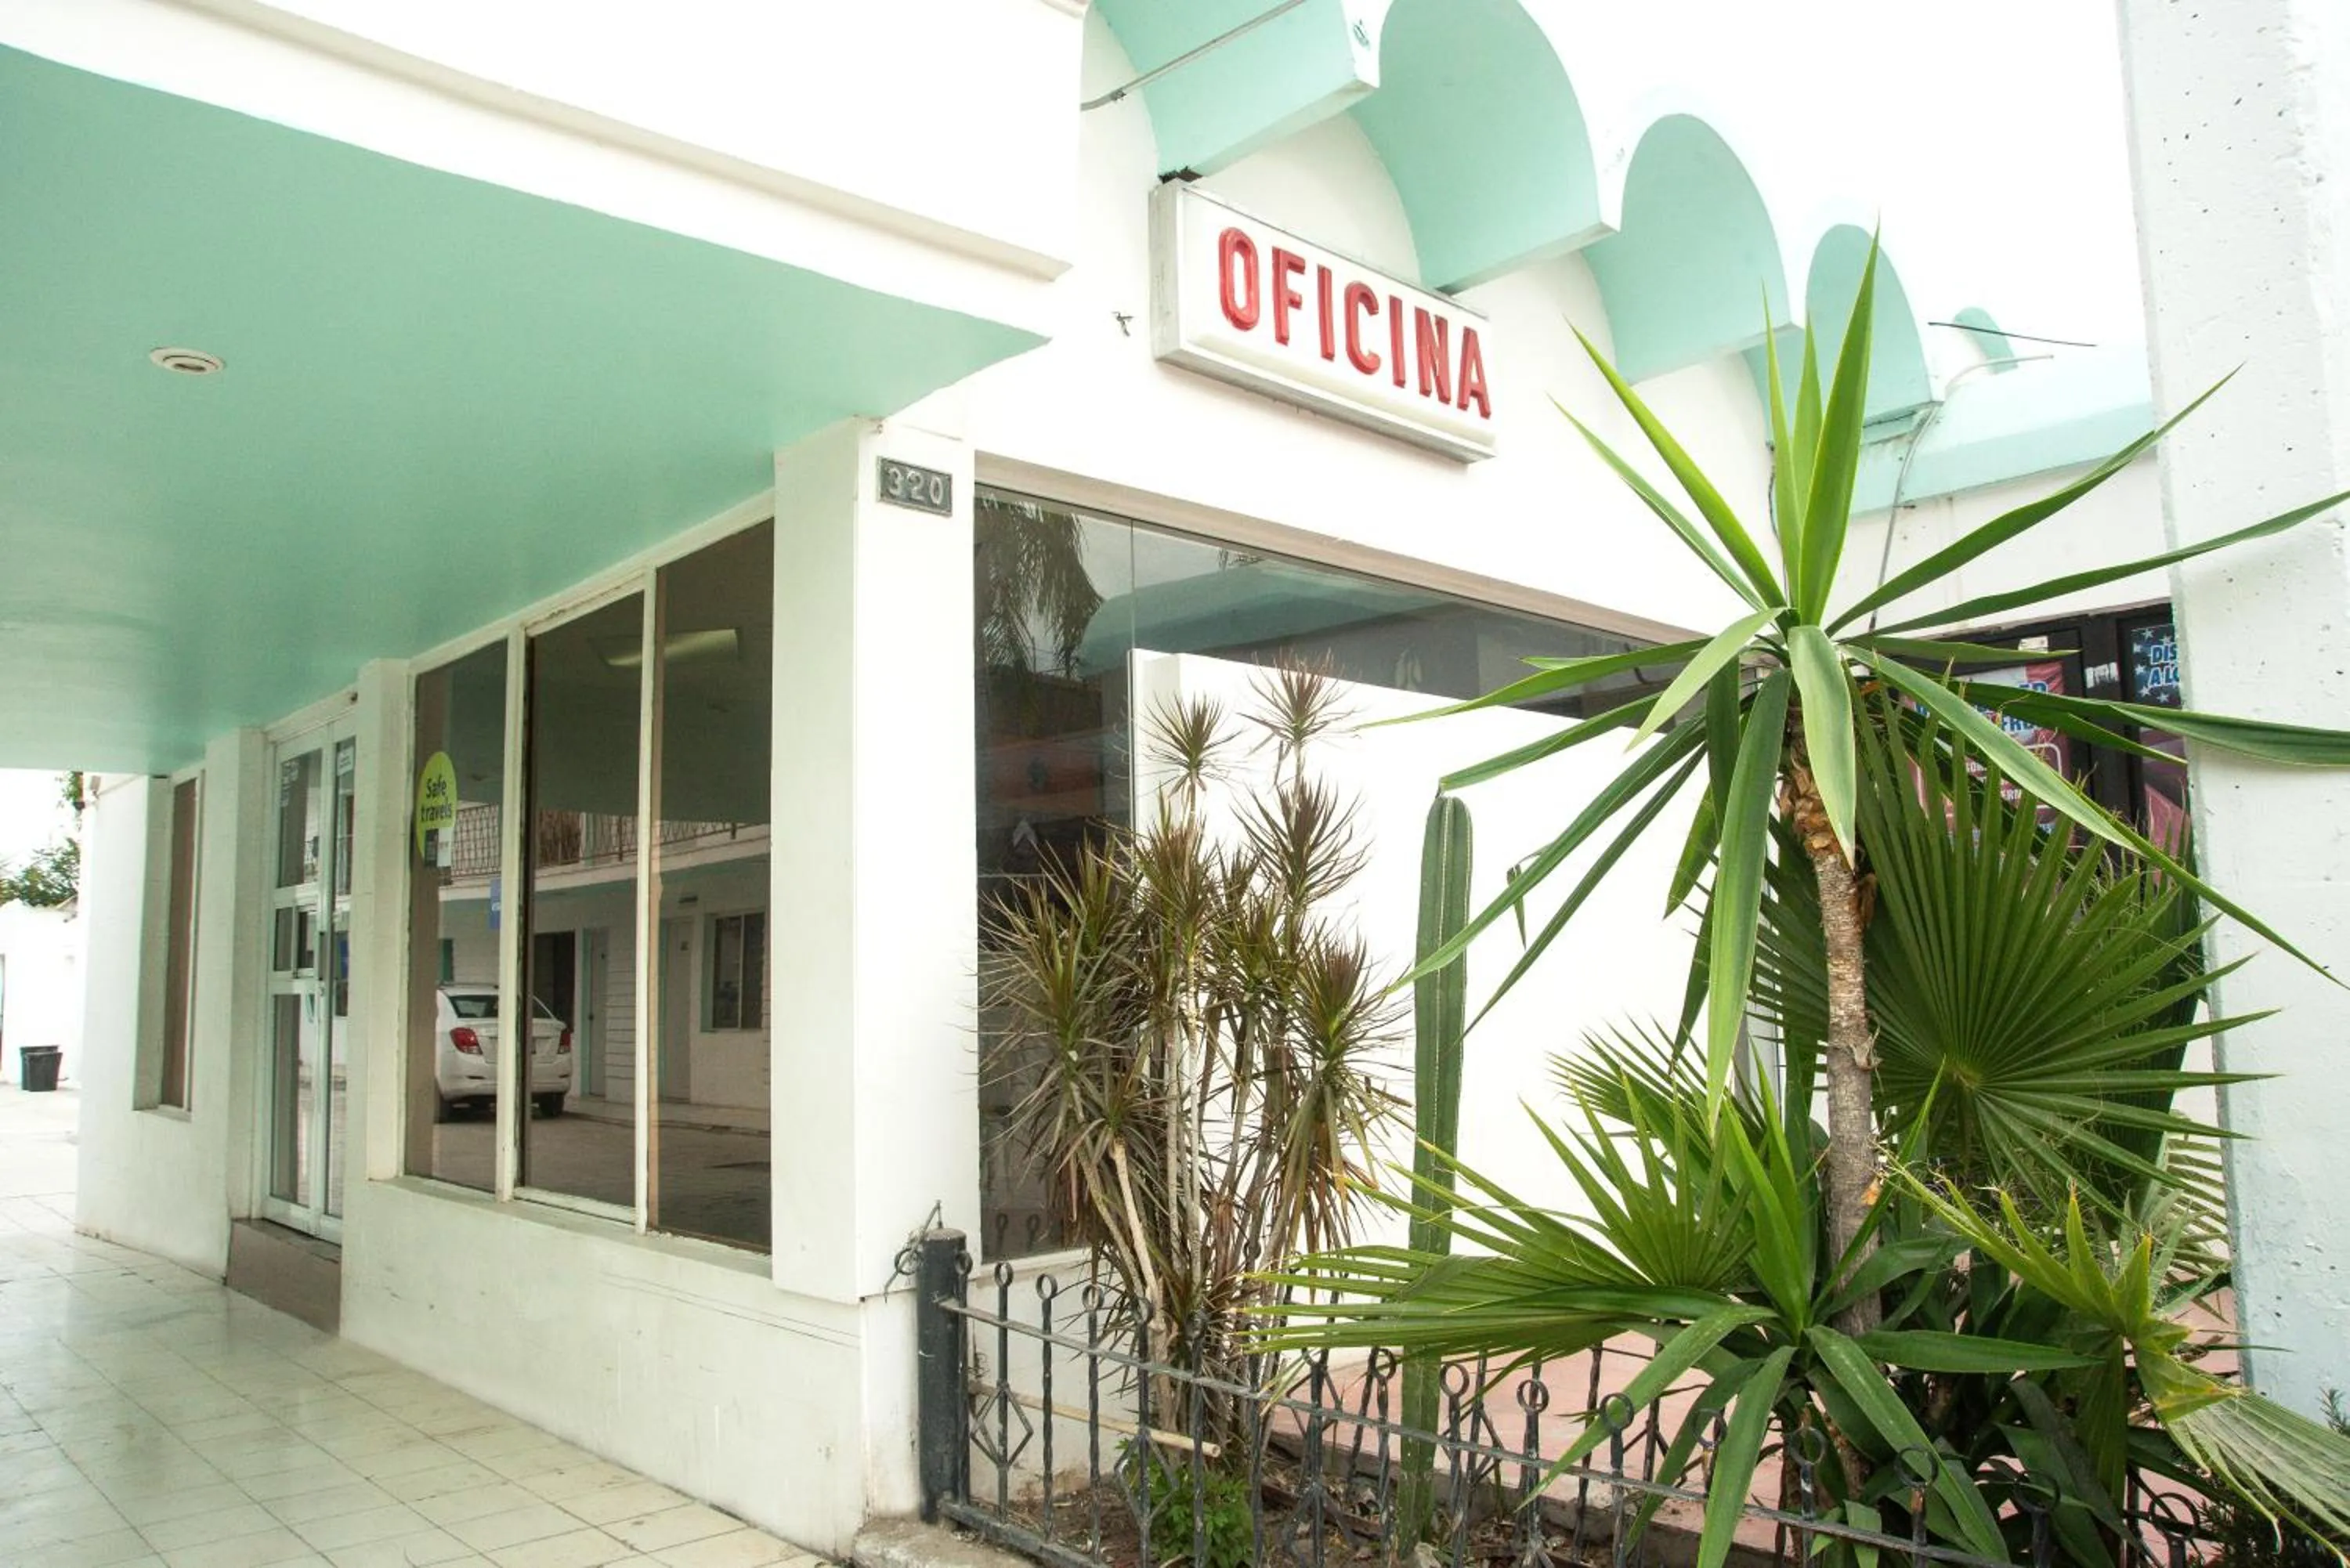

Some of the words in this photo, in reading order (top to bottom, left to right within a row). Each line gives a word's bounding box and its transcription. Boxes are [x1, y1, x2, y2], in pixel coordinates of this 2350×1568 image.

[1218, 226, 1491, 420] OFICINA
[887, 468, 943, 505] 320
[426, 774, 447, 798] Safe
[421, 802, 452, 822] travels
